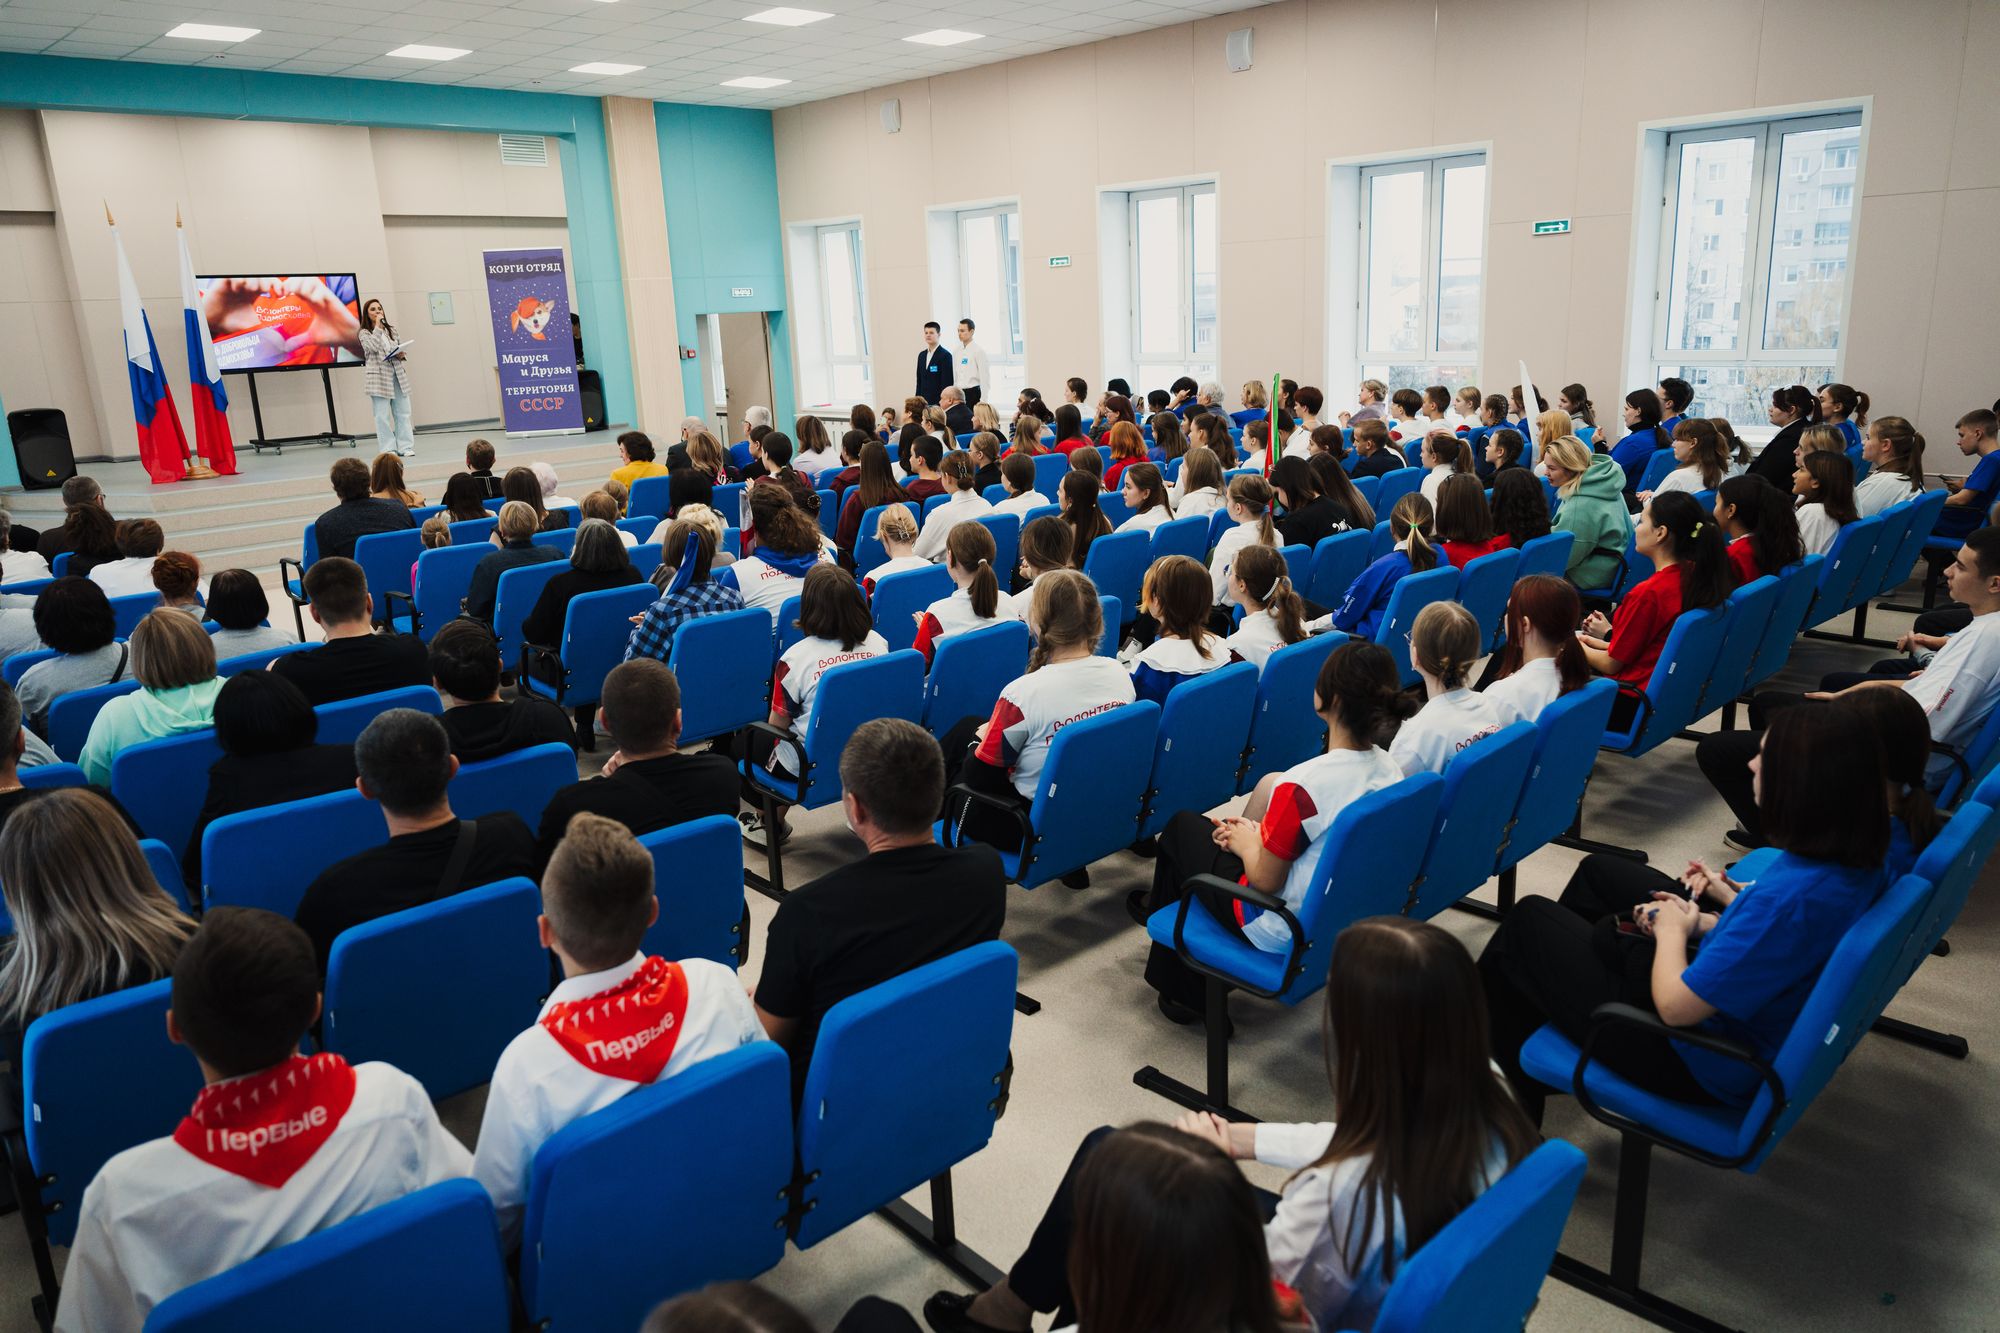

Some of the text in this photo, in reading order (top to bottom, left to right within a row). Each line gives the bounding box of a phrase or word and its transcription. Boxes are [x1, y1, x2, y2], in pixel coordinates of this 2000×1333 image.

[489, 263, 561, 274] КОРГИ ОТРЯД
[502, 354, 549, 365] Маруся
[521, 366, 572, 378] и Друзья
[505, 384, 575, 396] ТЕРРИТОРИЯ
[519, 397, 564, 412] СССР
[585, 1011, 676, 1064] Первые
[206, 1105, 328, 1157] Первые
